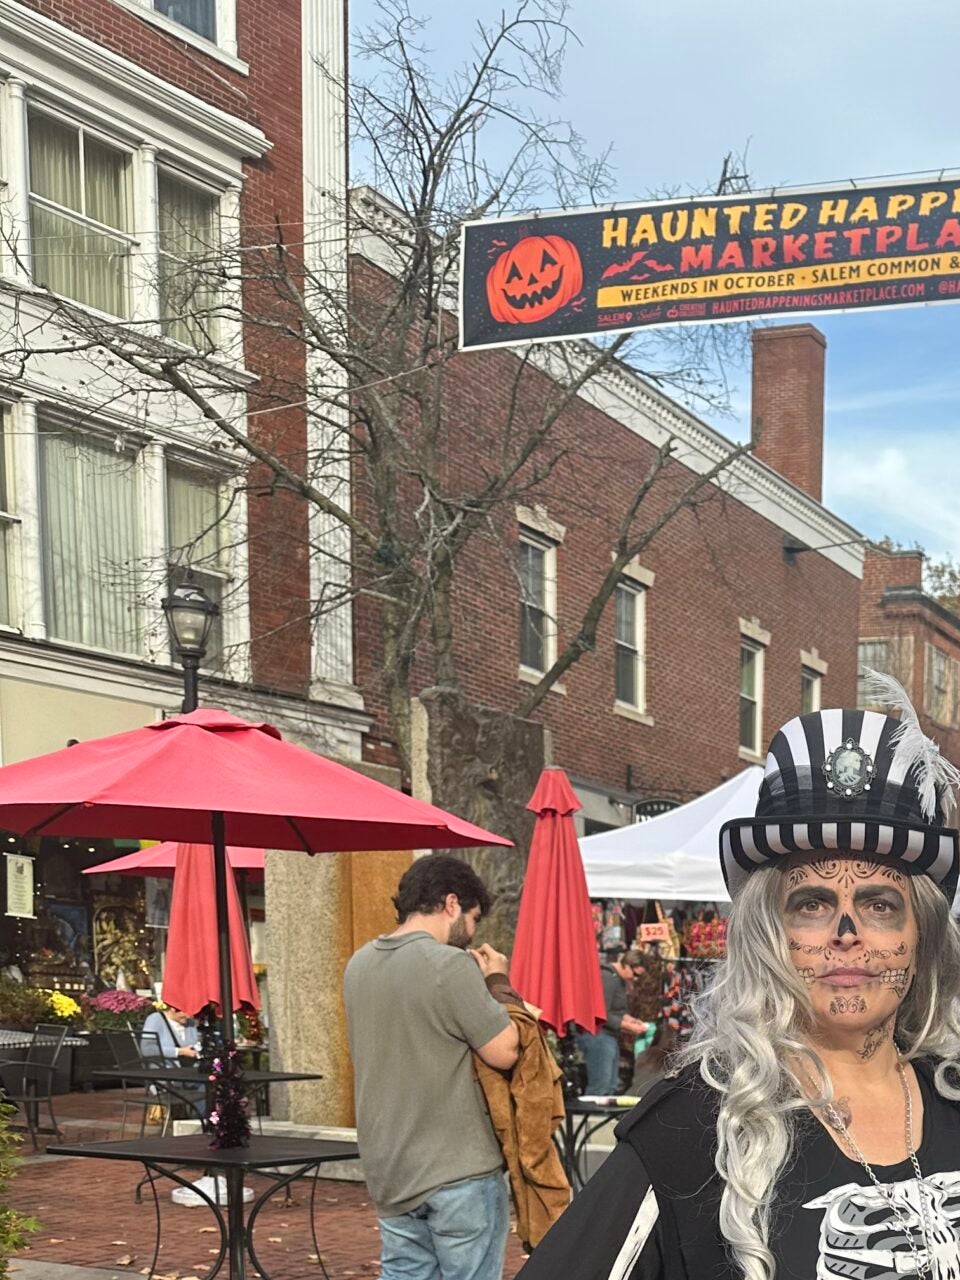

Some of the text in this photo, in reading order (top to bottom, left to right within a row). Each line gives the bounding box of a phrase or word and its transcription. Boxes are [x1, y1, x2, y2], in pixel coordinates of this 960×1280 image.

[602, 203, 808, 248] HAUNTED
[621, 281, 697, 302] WEEKENDS
[703, 279, 718, 293] IN
[724, 273, 795, 290] OCTOBER
[812, 265, 861, 283] SALEM
[867, 257, 942, 276] COMMON
[949, 256, 960, 269] &
[712, 283, 925, 315] HAUNTEDHAPPENINGSMARKETPLACE.COM
[645, 926, 664, 936] $25
